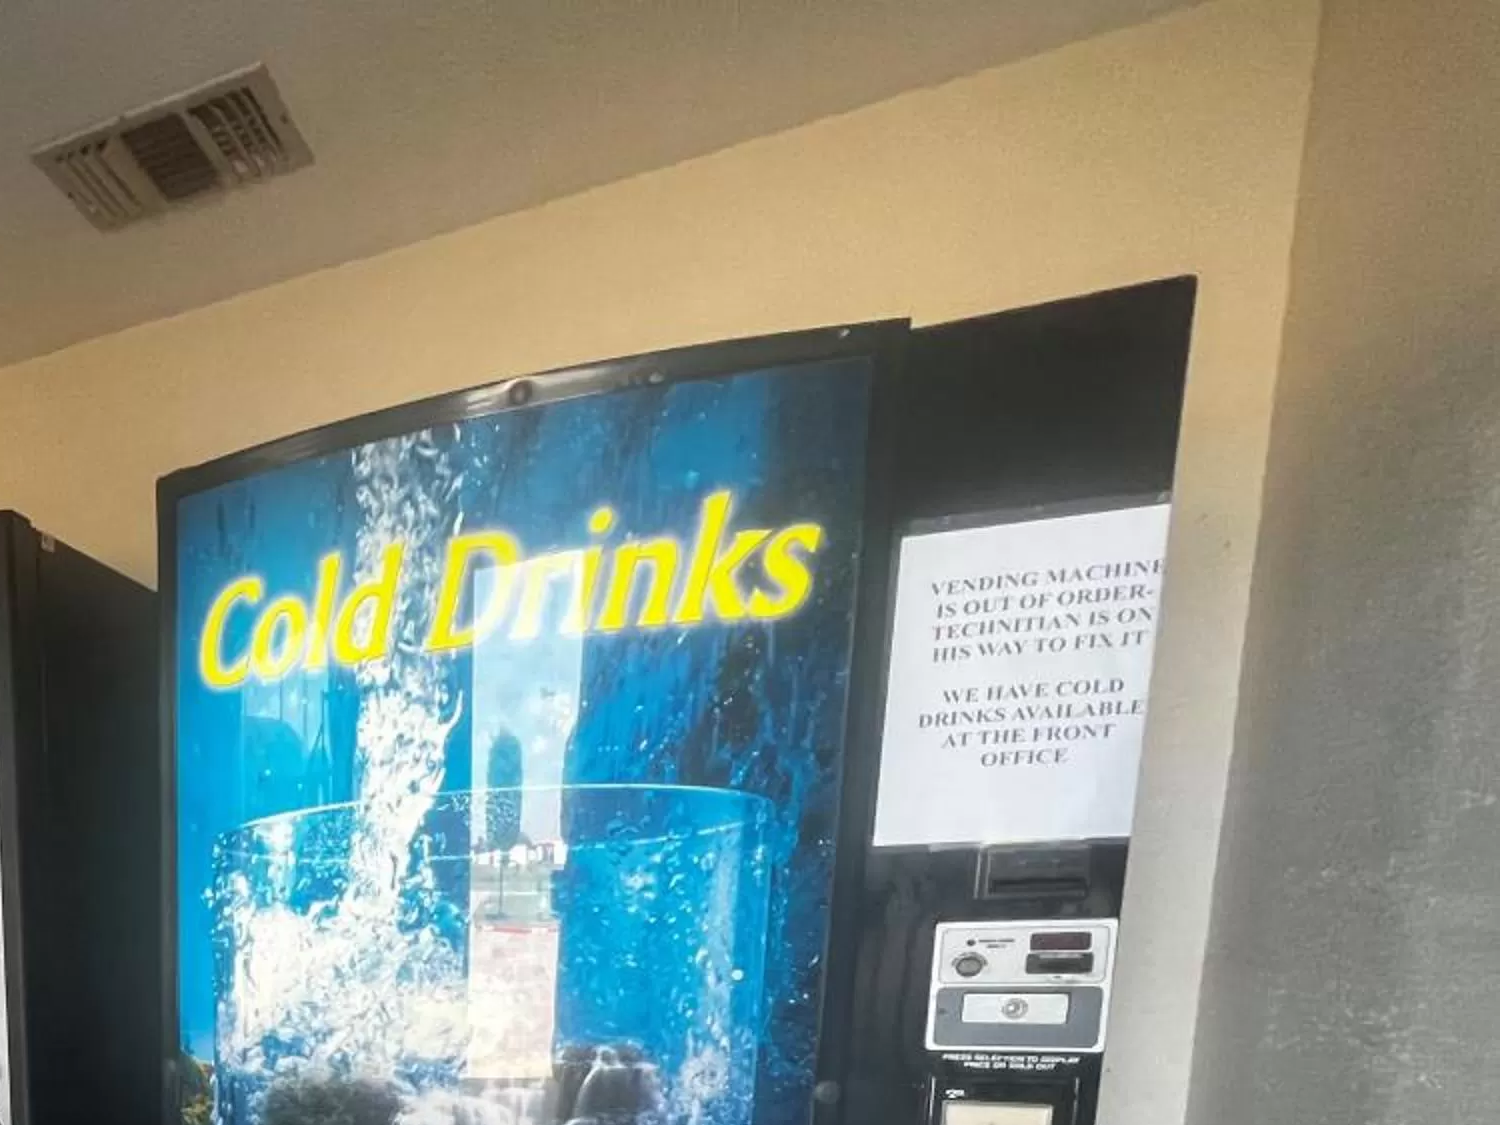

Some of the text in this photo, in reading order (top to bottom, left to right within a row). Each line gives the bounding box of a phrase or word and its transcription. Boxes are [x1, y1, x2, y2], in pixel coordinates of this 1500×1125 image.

[201, 491, 822, 687] Cold Drinks
[931, 572, 1040, 596] VENDING
[936, 602, 958, 619] IS
[963, 596, 1011, 616] OUT
[1019, 591, 1055, 610] OF
[932, 606, 1155, 641] TECHNITIAN IS ON
[932, 629, 1149, 663] HIS WAY TO FIX IT
[942, 677, 1125, 704] WE HAVE COLD
[919, 699, 1145, 729] DRINKS AVAILABLE
[941, 723, 1117, 749] AT THE FRONT
[980, 747, 1069, 768] OFFICE
